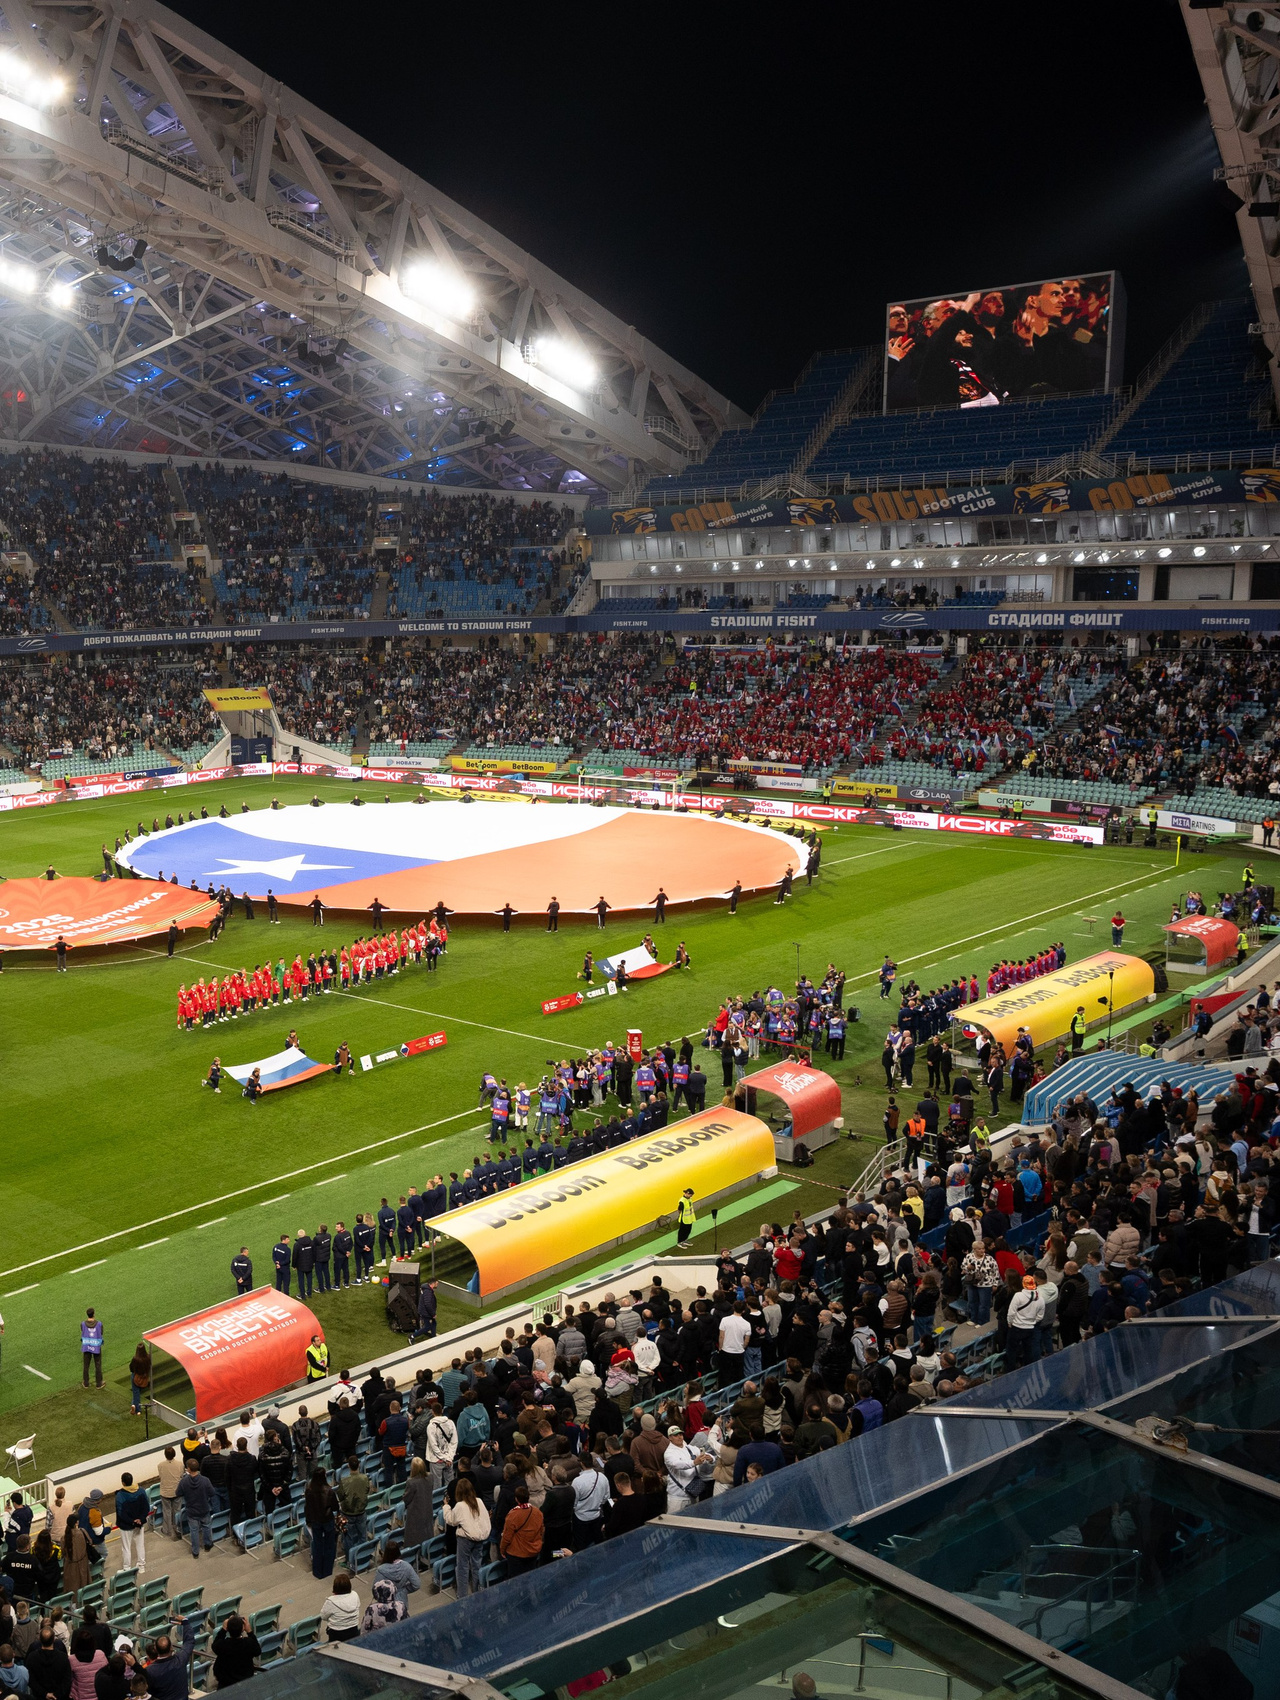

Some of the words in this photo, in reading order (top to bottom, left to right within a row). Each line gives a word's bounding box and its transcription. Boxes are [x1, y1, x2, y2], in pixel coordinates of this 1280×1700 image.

[922, 486, 991, 514] FOOTBALL
[1136, 475, 1214, 506] ФУТБОЛЬНЫЙ
[1191, 484, 1223, 500] КЛУБ
[707, 503, 768, 528] ФУТБОЛЬНЫЙ
[961, 497, 996, 514] CLUB
[749, 511, 774, 523] КЛУБ
[398, 623, 445, 632] WELCOME
[447, 622, 459, 630] TO
[461, 621, 504, 631] STADIUM
[505, 620, 532, 629] FISHT
[710, 616, 773, 627] STADIUM
[777, 615, 817, 627] FISHT
[988, 613, 1065, 627] СТАДИОН
[1069, 613, 1123, 626] ФИШТ
[1201, 617, 1250, 625] FISHT.INFO
[83, 636, 111, 647] ДОБРО
[113, 632, 173, 643] ПОЖАЛОВАТЬ
[175, 631, 187, 640] НА
[190, 630, 231, 640] СТАДИОН
[234, 629, 261, 638] ФИШТ
[466, 761, 498, 769] Betoom
[512, 762, 544, 771] BetBoom
[1191, 820, 1216, 832] RATINGS
[57, 891, 169, 931] ЗАЩИТНИКА
[1052, 960, 1127, 987] BetBoom
[976, 988, 1058, 1019] BetBoom
[613, 1122, 734, 1171] BetBoom
[469, 1174, 608, 1230] BetBoom
[178, 1302, 268, 1340] СИЛЬНЫЕ
[183, 1305, 292, 1355] ВМЕСТЕ
[200, 1346, 231, 1361] СБОРНАЯ
[231, 1334, 257, 1348] РОССИИ
[258, 1330, 268, 1338] ПО
[268, 1318, 298, 1333] ФУТБОЛУ
